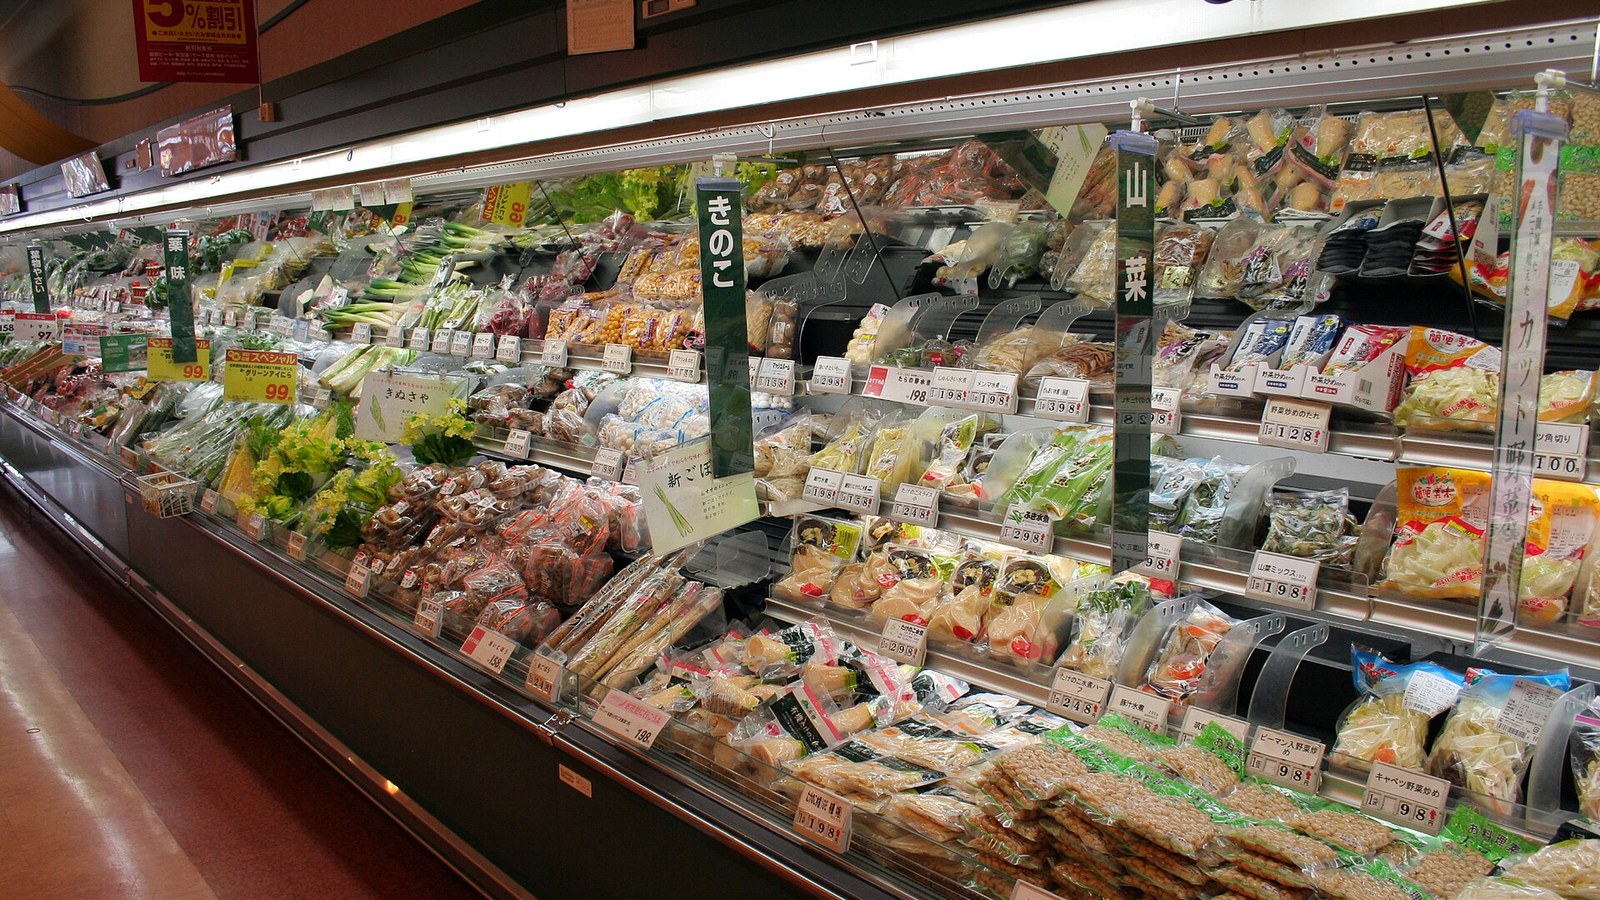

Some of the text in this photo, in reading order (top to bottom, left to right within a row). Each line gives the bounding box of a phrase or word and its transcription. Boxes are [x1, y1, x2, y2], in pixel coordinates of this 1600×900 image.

[1125, 161, 1148, 302] 山菜
[708, 196, 735, 289] きのこ
[168, 237, 186, 280] 薬味
[38, 331, 52, 340] 97
[251, 353, 296, 365] スペシャル
[183, 365, 204, 379] 99
[245, 368, 293, 379] グリーンアイにら
[766, 377, 784, 387] 158
[820, 377, 840, 387] 298
[266, 384, 289, 401] 99
[385, 387, 430, 404] きぬさや
[910, 389, 927, 402] 198
[940, 390, 962, 401] 198
[981, 395, 1005, 406] 198
[1048, 402, 1076, 414] 398
[1270, 405, 1320, 420] 野菜炒めのたれ
[1277, 425, 1312, 442] 128
[1535, 456, 1575, 473] 100
[668, 460, 713, 488] 新ごぼ
[814, 488, 833, 500] 198
[848, 496, 869, 507] 158
[903, 505, 926, 519] 248
[1023, 511, 1050, 523] ふき水煮
[1013, 530, 1039, 543] 298
[1144, 557, 1165, 570] 98
[1257, 563, 1297, 577] 山菜ミックス
[1264, 581, 1299, 599] 198
[890, 641, 914, 657] 298
[490, 655, 503, 668] 158
[1062, 697, 1092, 714] 248
[1120, 698, 1145, 712] 豚汁水煮
[634, 728, 652, 744] 198
[1259, 733, 1318, 756] ピーマン入野菜炒
[1278, 765, 1304, 782] 98
[1375, 772, 1440, 798] キャベツ野菜炒め
[1399, 802, 1426, 821] 98
[808, 818, 836, 839] 198
